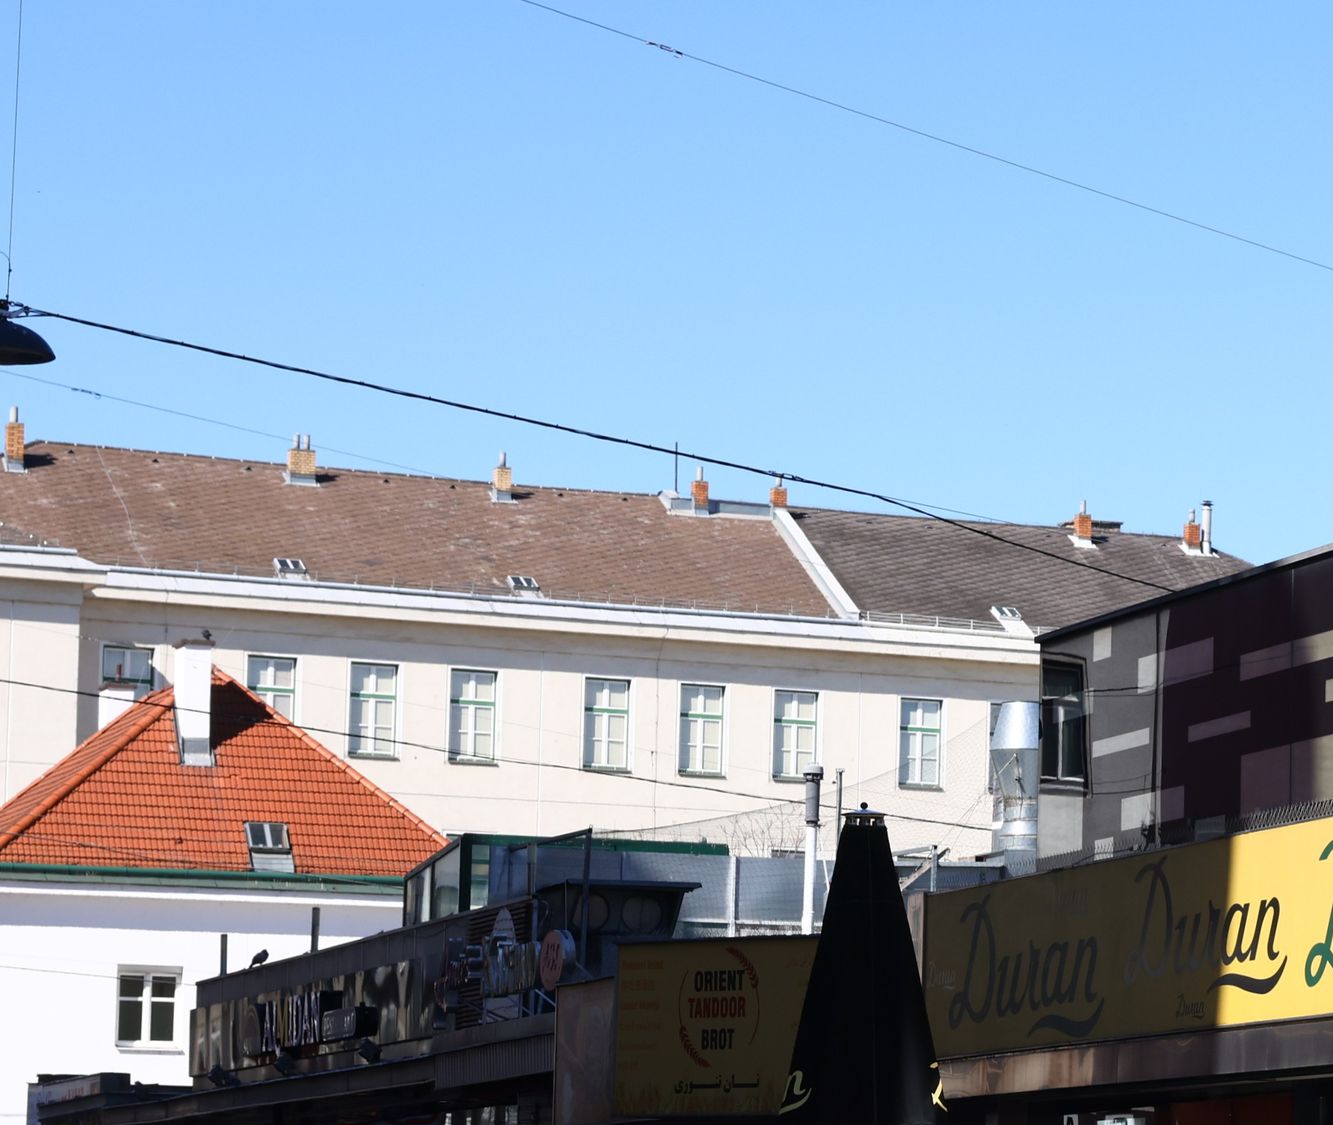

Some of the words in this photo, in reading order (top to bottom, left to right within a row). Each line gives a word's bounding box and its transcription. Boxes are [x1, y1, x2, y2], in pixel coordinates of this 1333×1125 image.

[1123, 856, 1287, 995] Duran
[949, 895, 1104, 1037] Duran
[694, 970, 746, 992] ORIENT
[688, 997, 747, 1019] TANDOOR
[1175, 993, 1208, 1020] Duran
[701, 1028, 735, 1050] BROT
